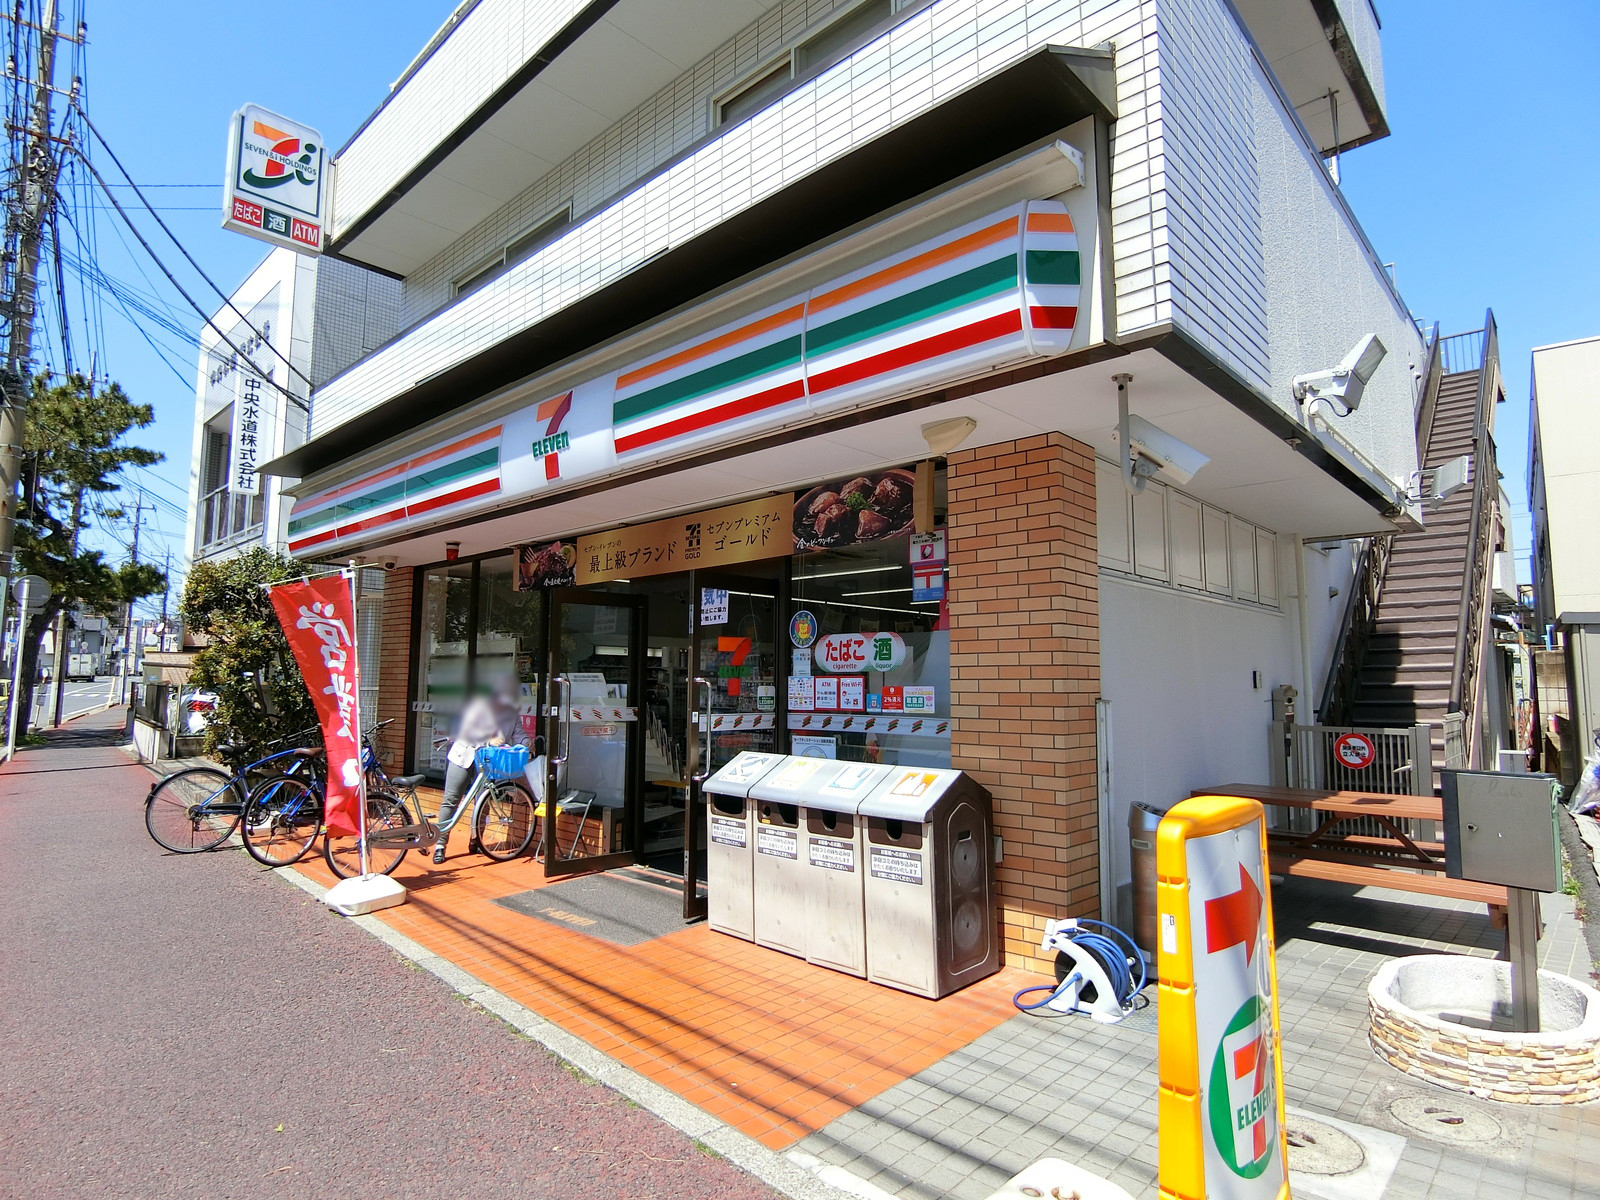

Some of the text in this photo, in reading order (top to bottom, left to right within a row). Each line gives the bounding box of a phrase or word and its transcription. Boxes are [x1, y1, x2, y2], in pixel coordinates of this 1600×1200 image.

[279, 155, 317, 176] HOLDINGS
[233, 201, 261, 224] たばこ
[268, 213, 287, 232] 酒
[293, 222, 318, 243] ATM
[237, 378, 261, 490] 中央水道株式会社
[706, 512, 781, 535] セブンプレミアム
[714, 527, 771, 551] ゴールド
[589, 541, 677, 574] 最上級ブランド
[684, 551, 701, 560] GOLD
[825, 638, 866, 662] たばこ
[873, 637, 892, 662] 酒
[832, 662, 858, 670] cigarette
[875, 662, 893, 670] liquor
